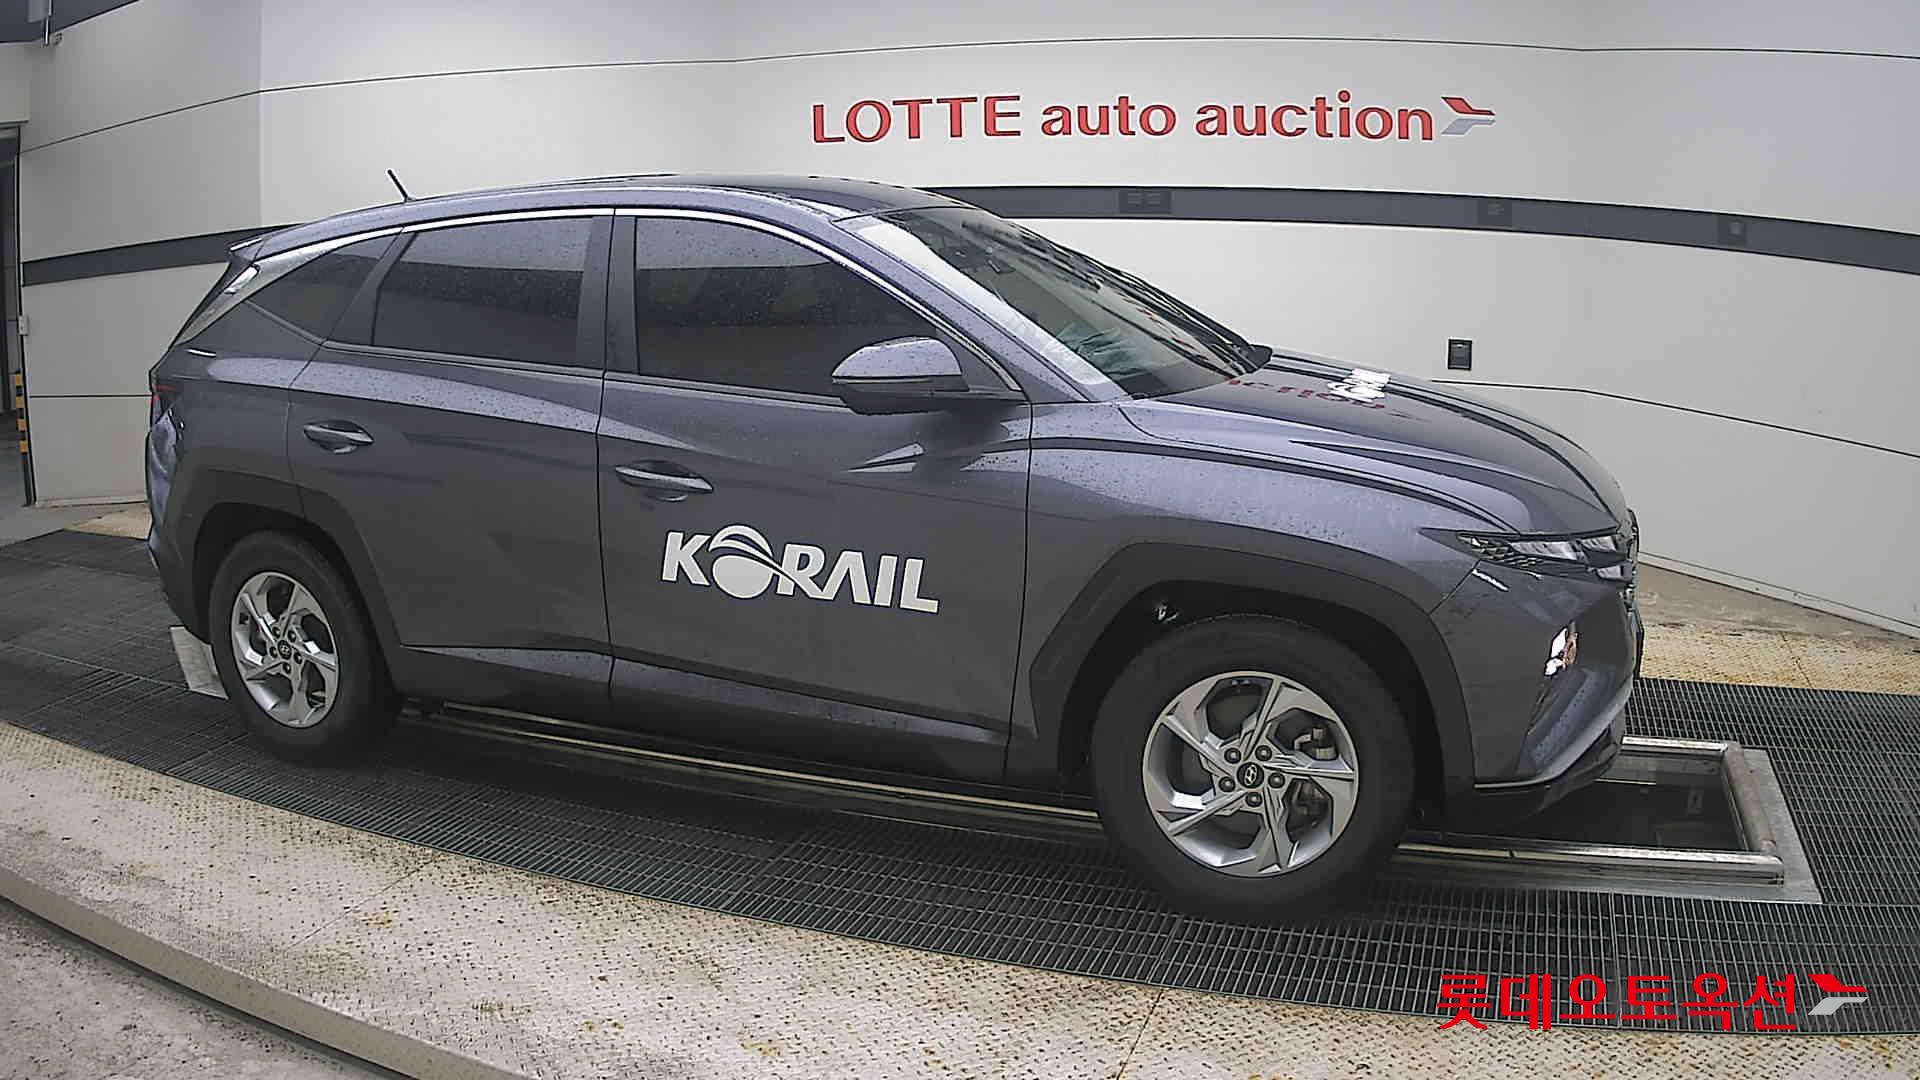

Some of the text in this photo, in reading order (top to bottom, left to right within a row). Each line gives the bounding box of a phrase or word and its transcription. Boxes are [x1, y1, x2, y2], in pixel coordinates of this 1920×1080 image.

[812, 90, 1435, 143] LOTTE auto auction
[661, 524, 940, 614] KORAIL
